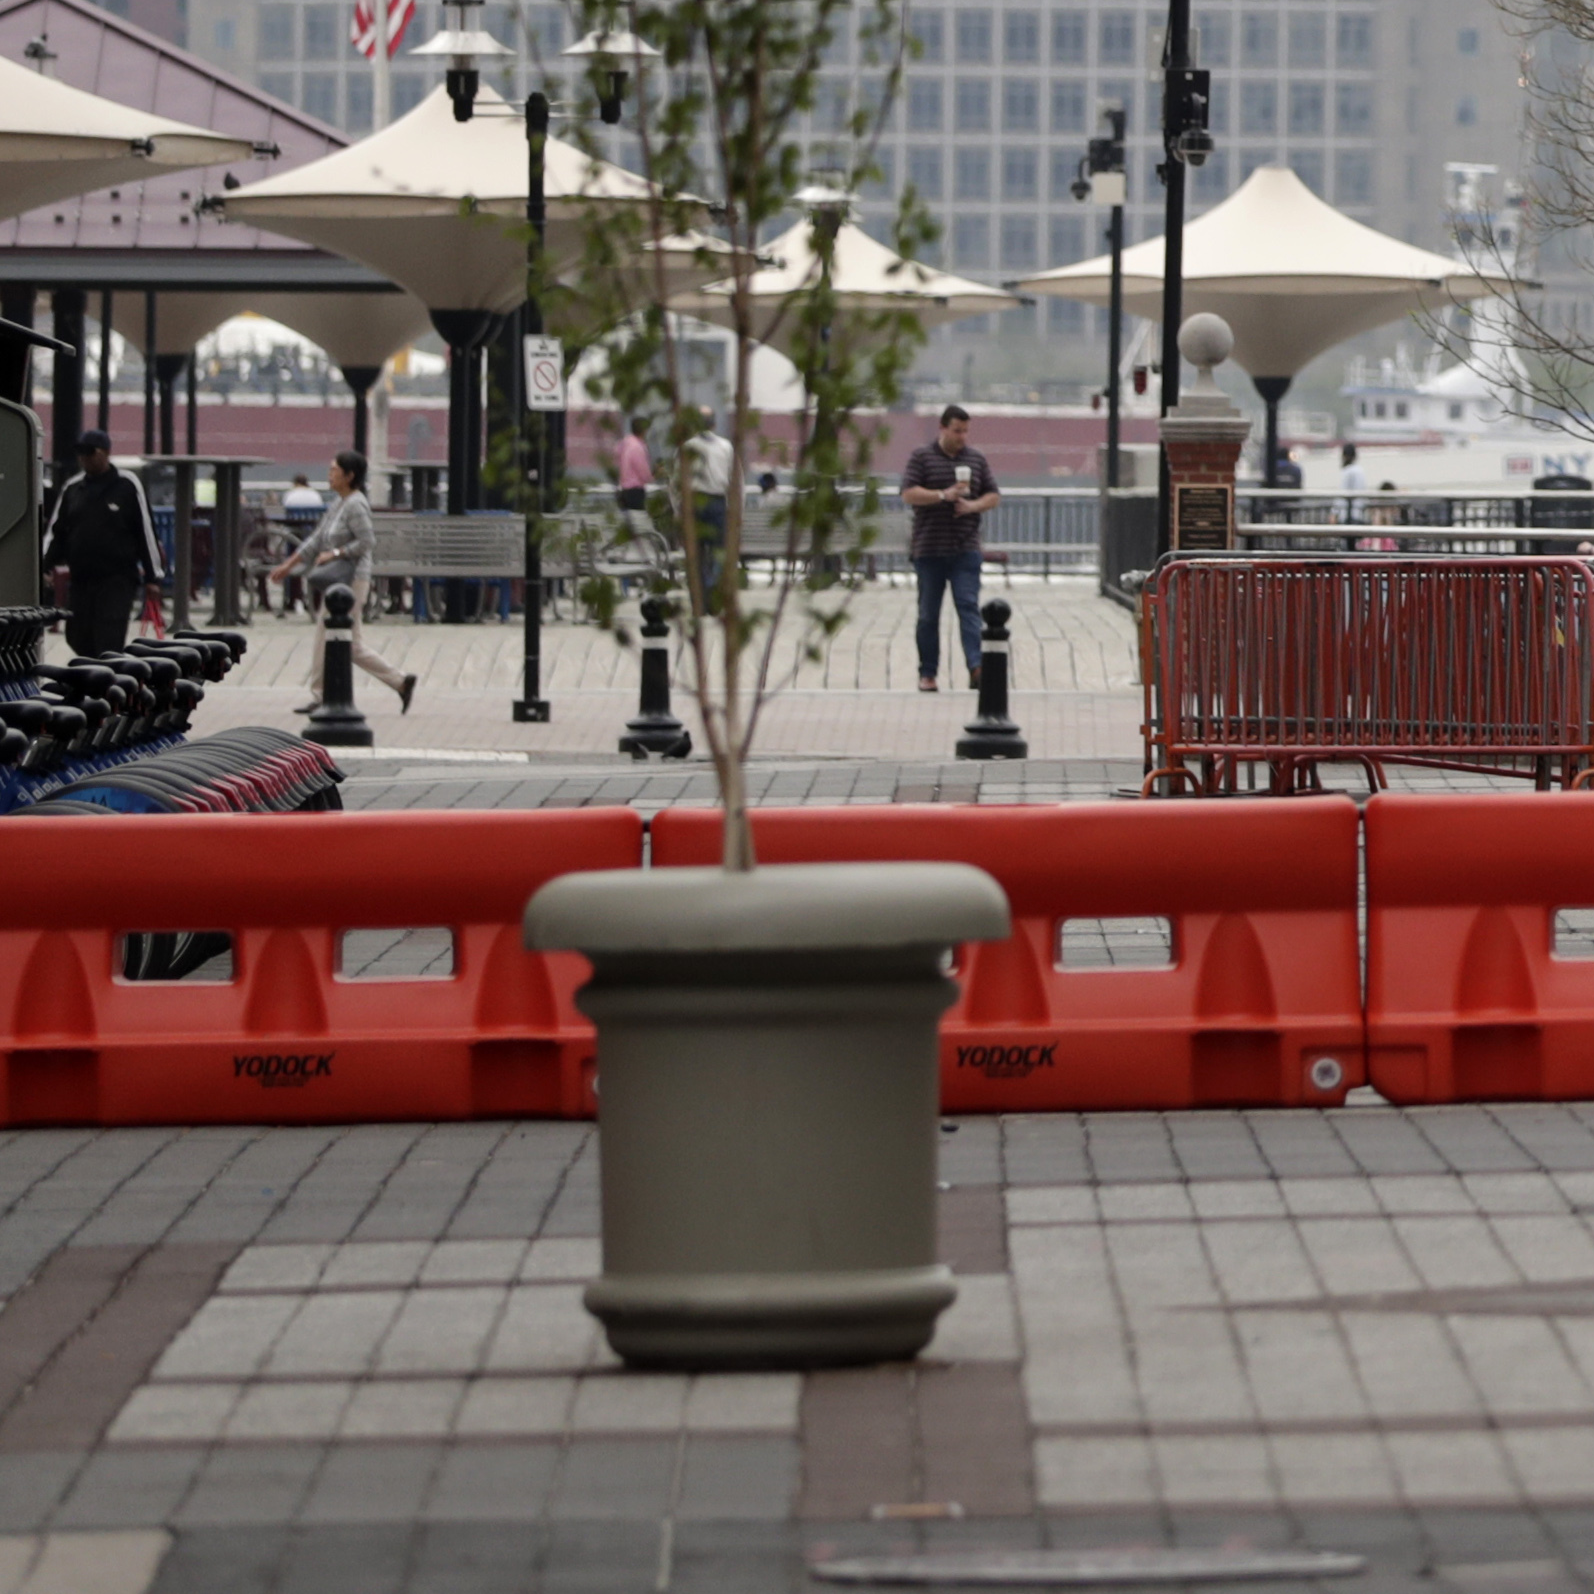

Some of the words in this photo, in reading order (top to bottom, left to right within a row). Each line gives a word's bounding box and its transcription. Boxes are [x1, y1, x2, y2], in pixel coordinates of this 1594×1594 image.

[1543, 452, 1590, 476] NY
[232, 1051, 336, 1078] YODOCK
[956, 1040, 1059, 1068] YODOCK
